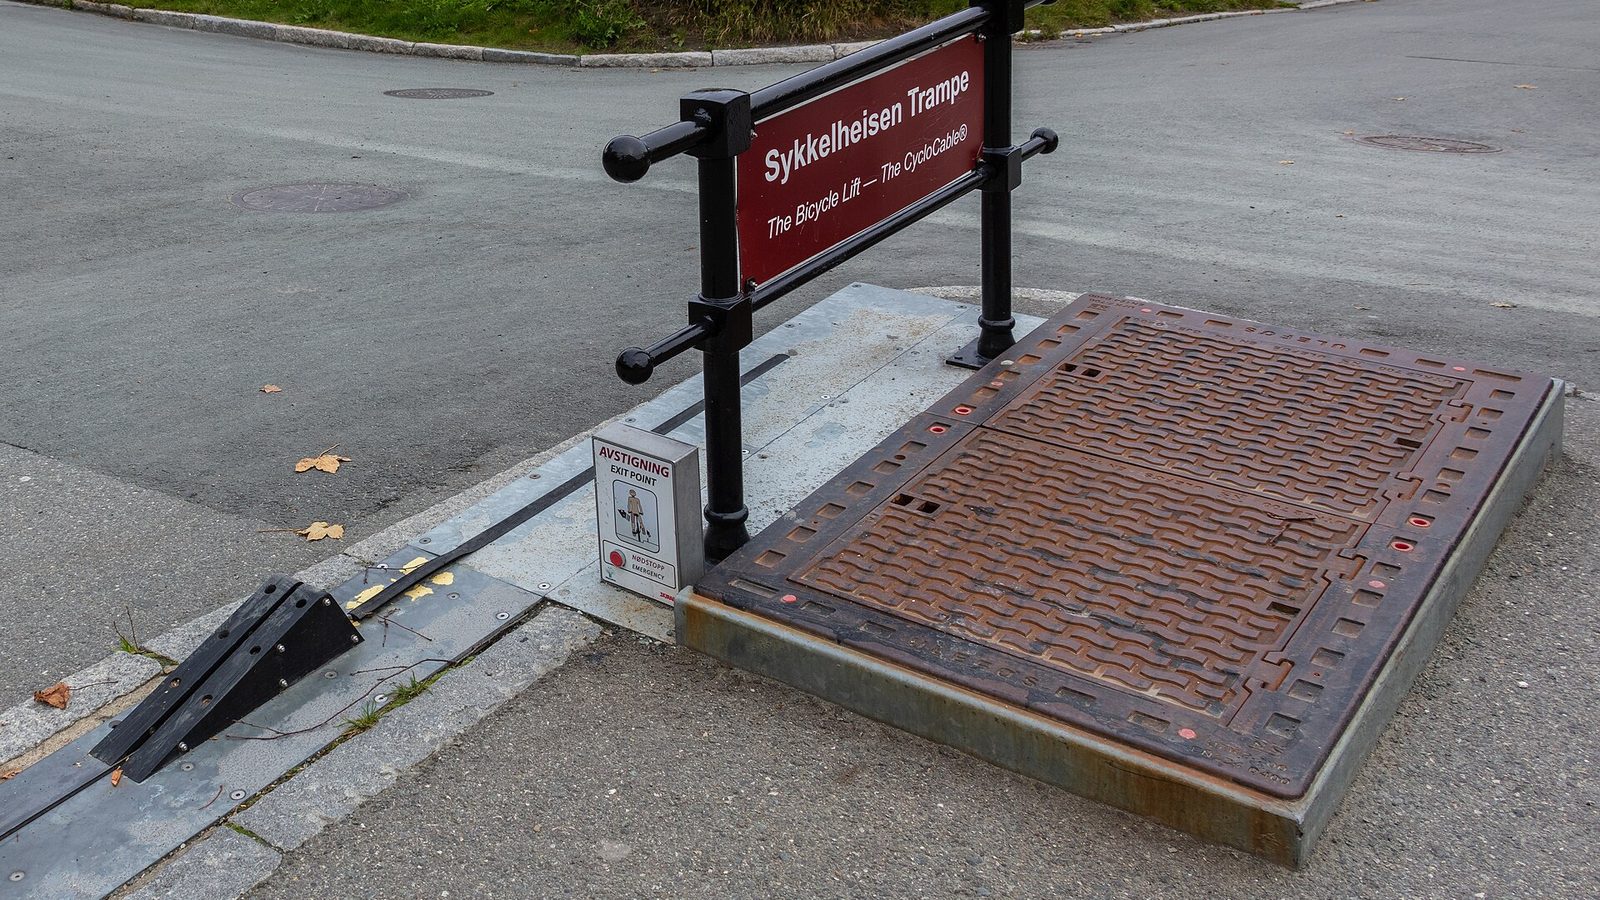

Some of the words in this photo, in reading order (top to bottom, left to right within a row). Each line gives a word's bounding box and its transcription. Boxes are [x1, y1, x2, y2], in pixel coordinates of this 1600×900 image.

[764, 102, 902, 185] Sykkelheisen
[908, 70, 970, 117] Trampe
[767, 215, 792, 239] The
[795, 190, 839, 226] Bicycle
[842, 176, 862, 202] Lift
[881, 162, 901, 184] The
[599, 446, 670, 479] AVSTIGNING
[610, 464, 630, 478] EXIT
[630, 471, 658, 487] POINT
[632, 554, 665, 571] NØDSTOPP
[632, 564, 665, 581] EMERGENCY
